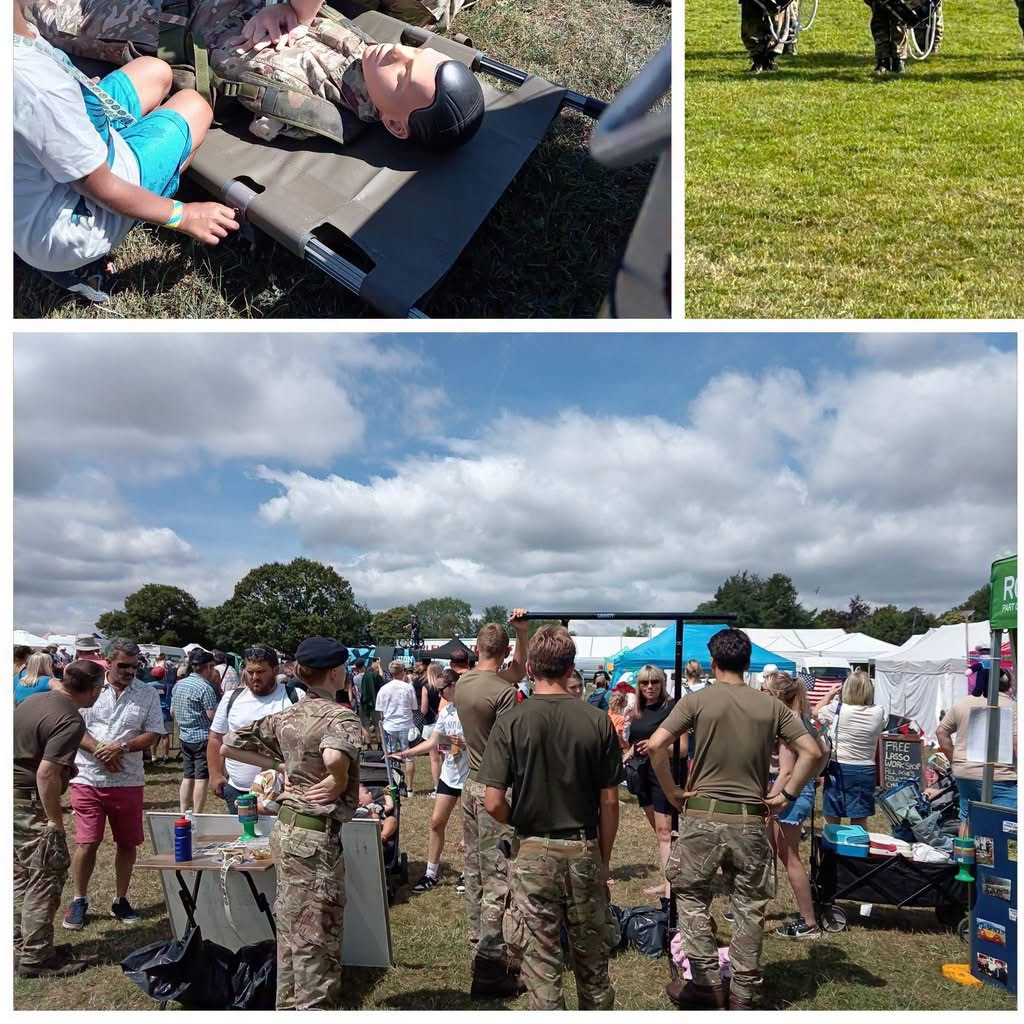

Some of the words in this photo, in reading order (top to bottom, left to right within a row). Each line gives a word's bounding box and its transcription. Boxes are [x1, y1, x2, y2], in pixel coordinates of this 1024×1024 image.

[1001, 602, 1015, 613] PART
[885, 740, 911, 753] FREE
[885, 751, 911, 762] LASSO
